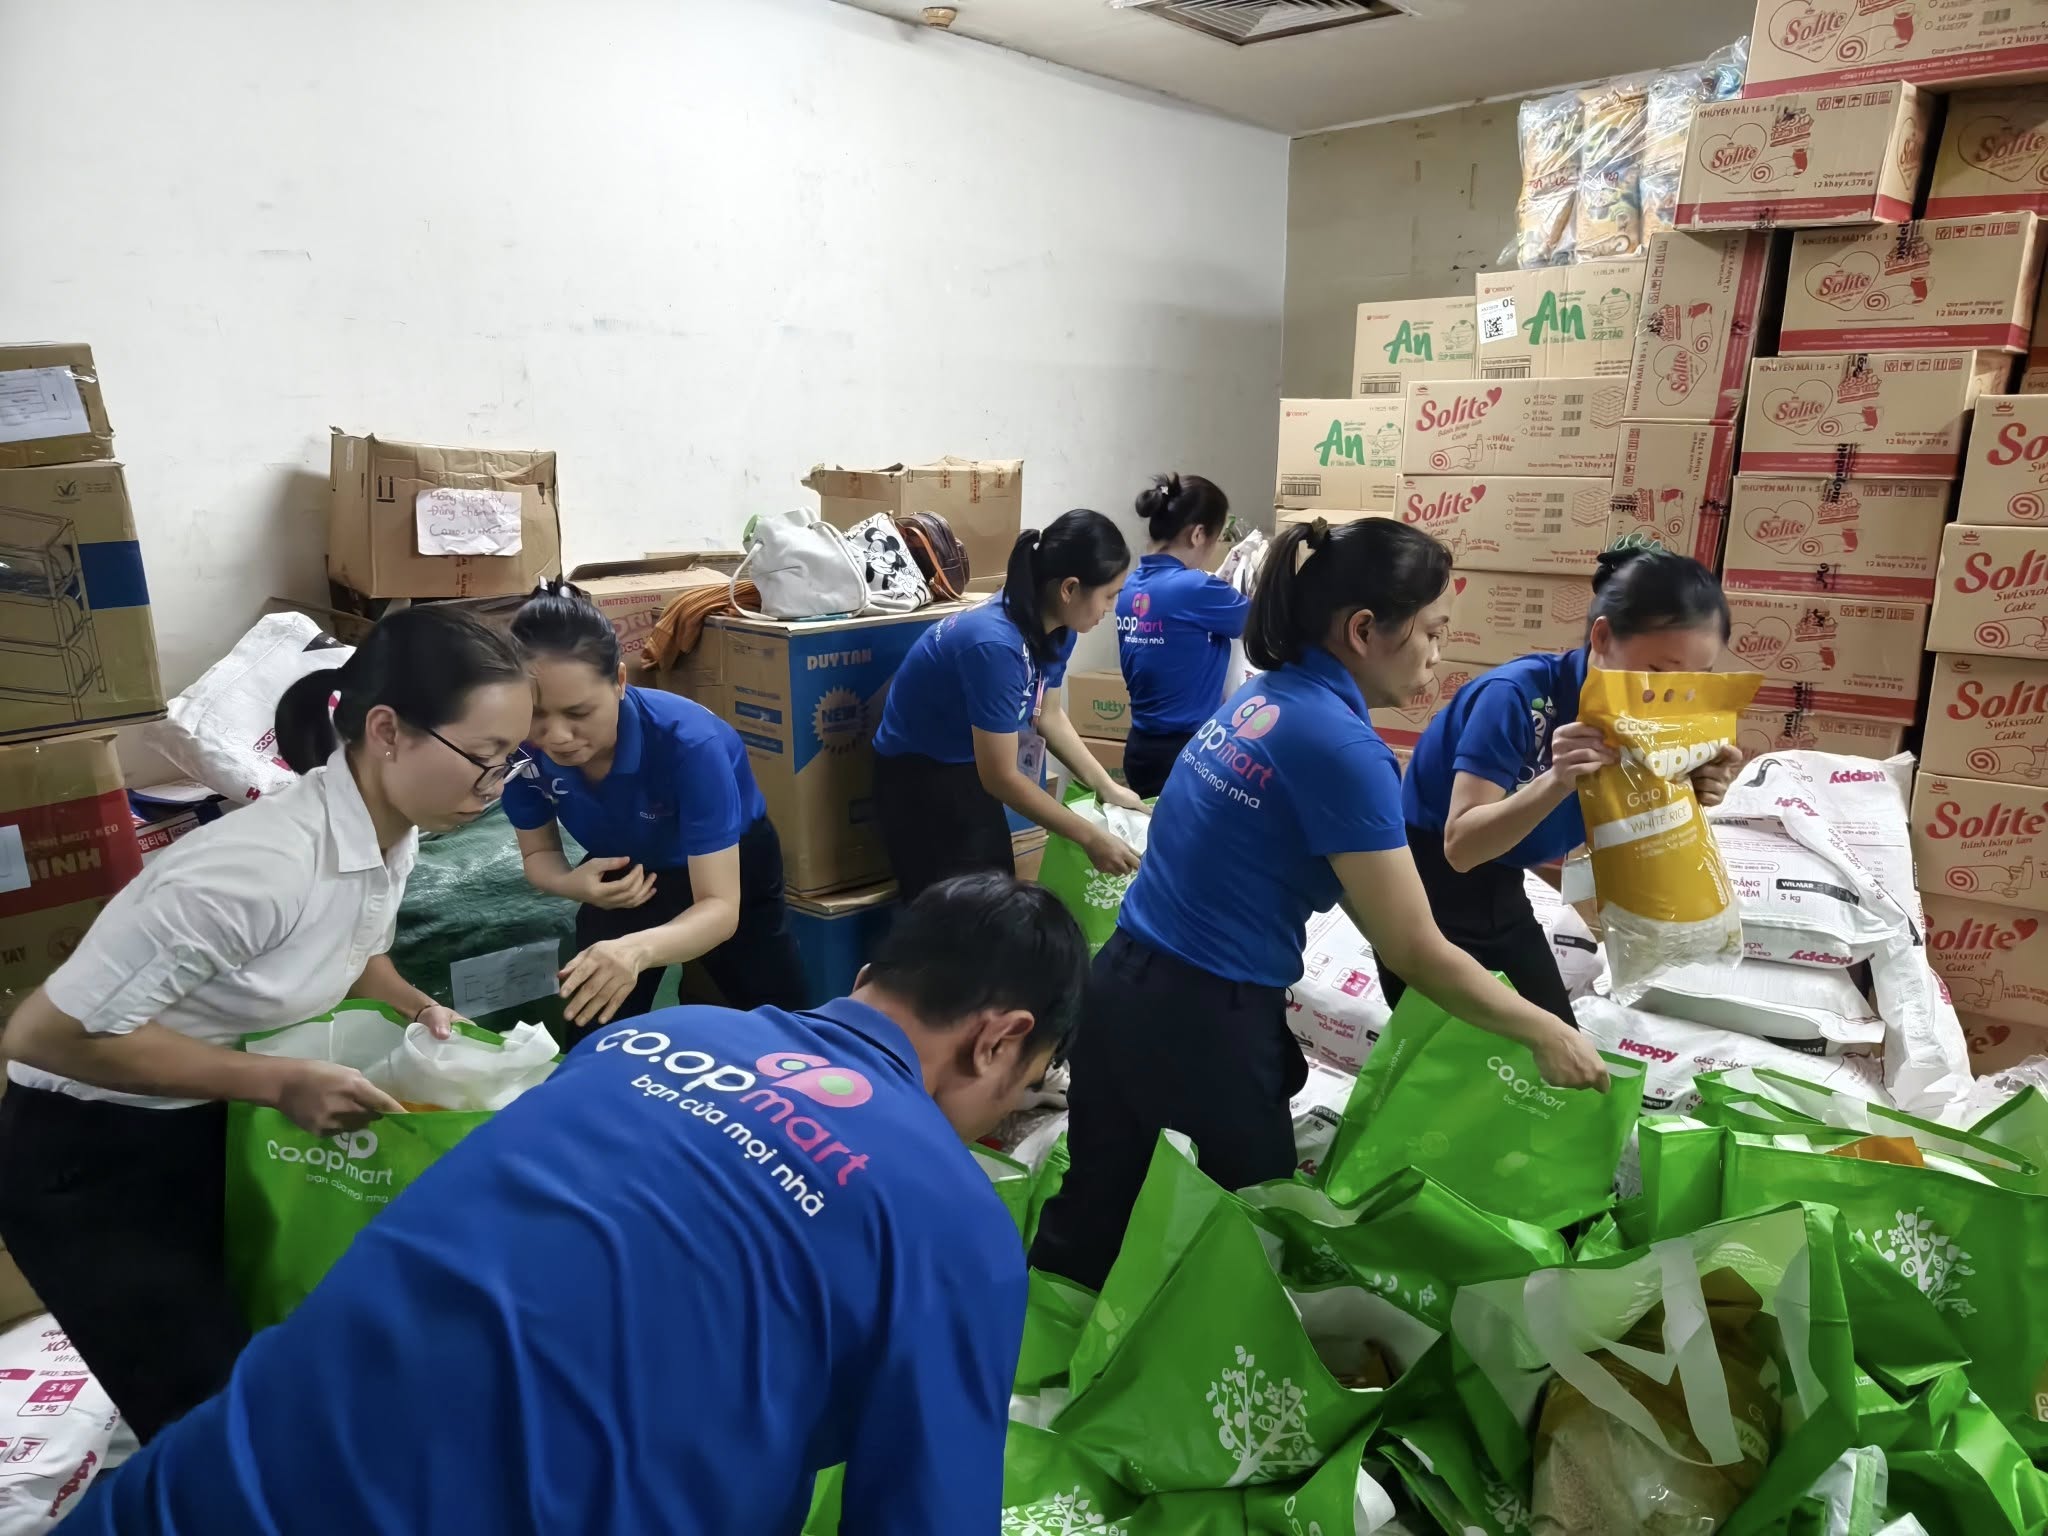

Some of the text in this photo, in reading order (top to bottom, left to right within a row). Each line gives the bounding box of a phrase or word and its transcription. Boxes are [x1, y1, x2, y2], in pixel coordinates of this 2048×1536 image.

[1783, 10, 1846, 46] Solite
[1711, 144, 1758, 169] Solite
[1814, 181, 1823, 189] 12
[1824, 180, 1844, 190] khay
[1819, 272, 1871, 297] Solite
[1522, 290, 1587, 345] An
[1936, 309, 1946, 317] 12
[1382, 320, 1434, 365] An
[1669, 350, 1689, 394] Solite
[1415, 395, 1490, 433] Solite
[1775, 401, 1825, 422] Solite
[1314, 419, 1365, 467] An
[1885, 438, 1894, 446] 12
[1584, 460, 1601, 470] khay
[1402, 491, 1474, 525] Solite
[1757, 519, 1805, 539] Solite
[598, 594, 662, 607] LIMITED EDITION
[2004, 602, 2037, 613] Cake
[1149, 636, 1165, 646] nhà
[1736, 635, 1783, 654] Solite
[1093, 699, 1126, 714] nutty
[1985, 715, 2044, 729] Swissroll
[1994, 731, 2027, 741] Cake
[1181, 747, 1196, 766] bạn
[1828, 769, 1886, 785] Happy
[1631, 815, 1666, 834] WHITE
[1925, 800, 2046, 839] Solite
[1737, 889, 1761, 898] MỀM
[1781, 881, 1815, 889] WILMAR
[1780, 893, 1801, 903] 5 kg
[1788, 949, 1854, 967] Happy
[1945, 962, 1975, 972] Cake
[1618, 1037, 1679, 1064] Happy
[630, 1074, 826, 1218] bạn của mọi nhà
[46, 1383, 76, 1393] 5 kg
[45, 1405, 59, 1413] kg
